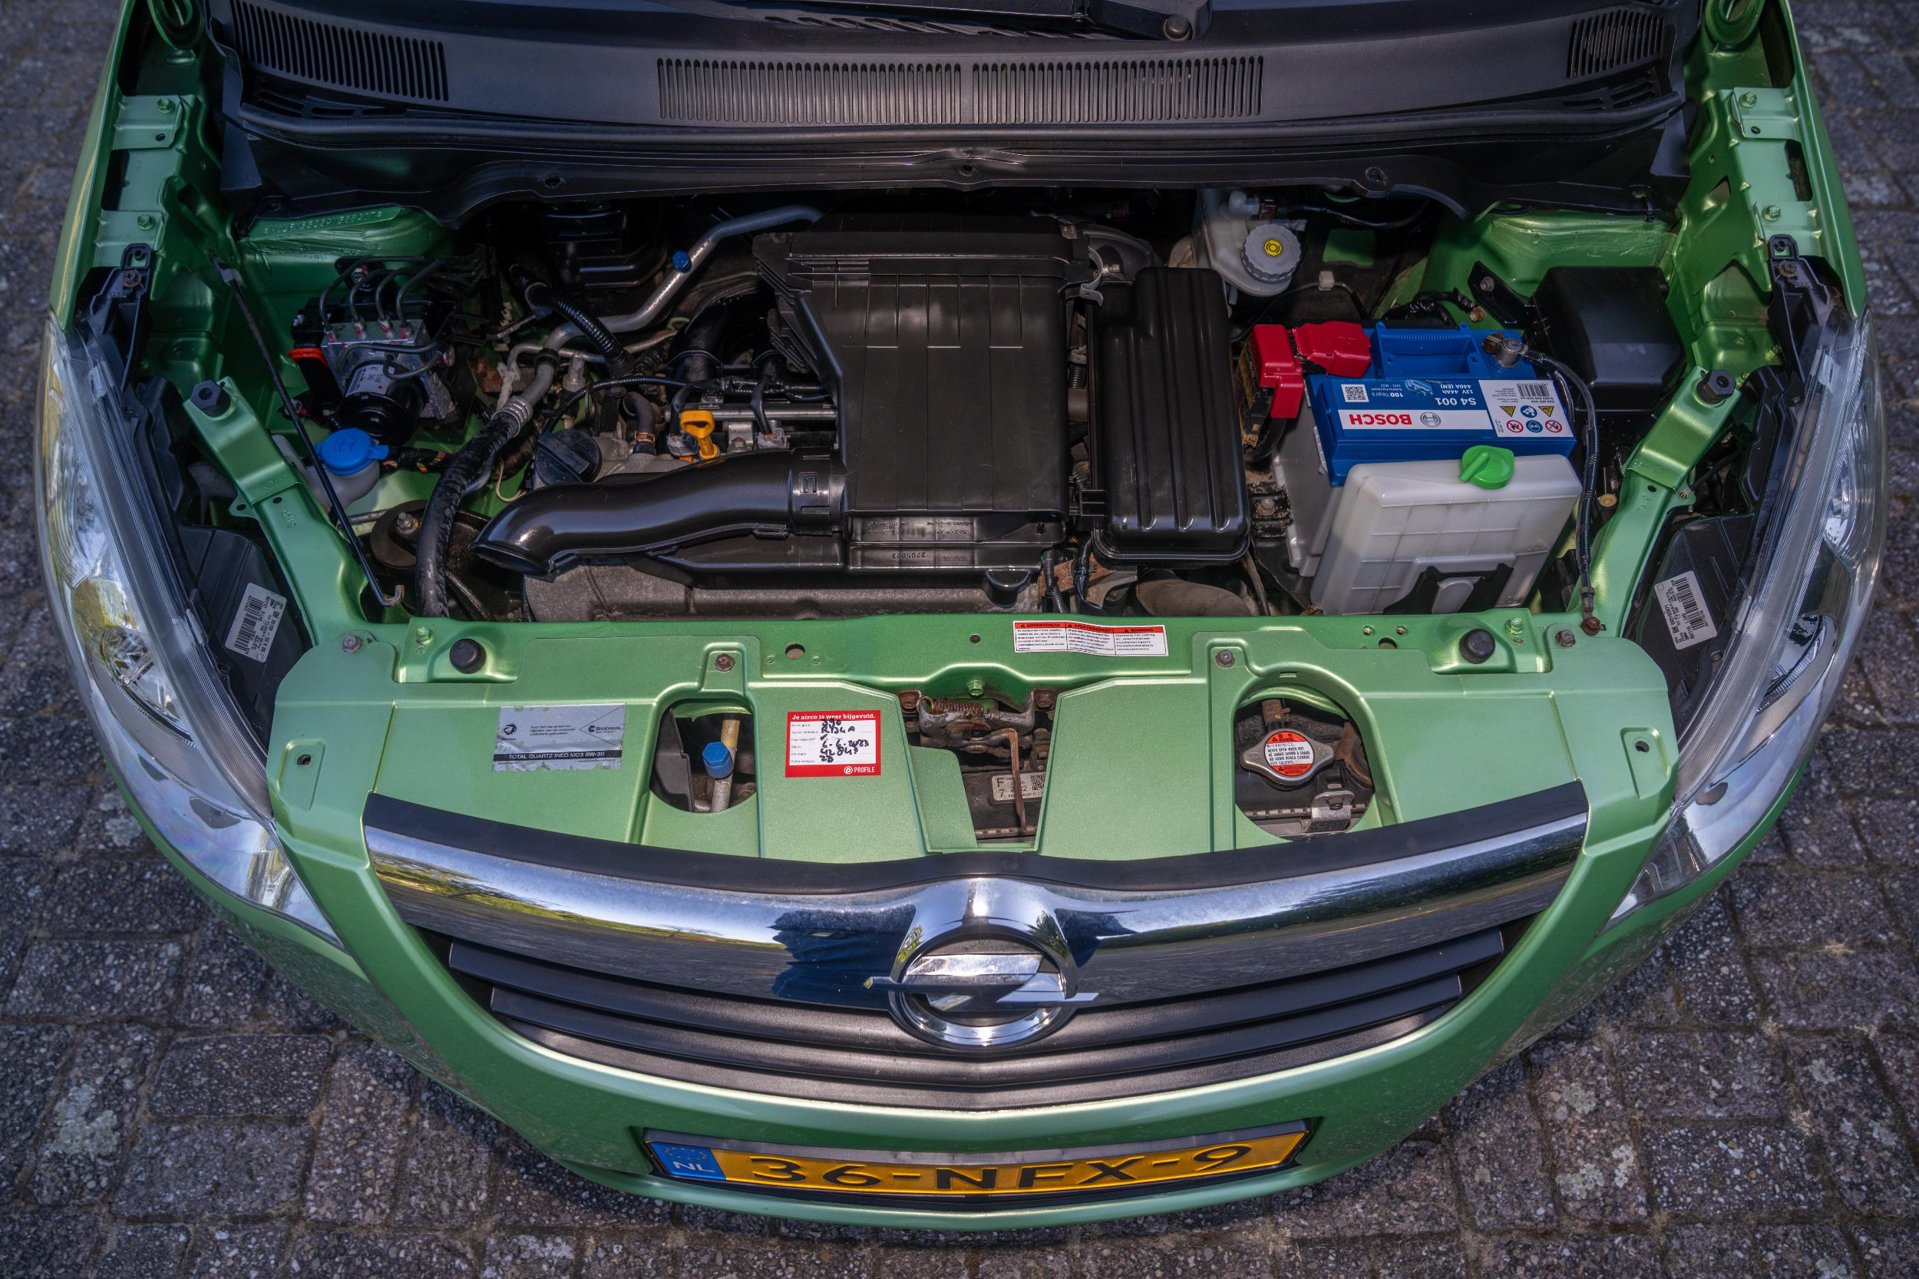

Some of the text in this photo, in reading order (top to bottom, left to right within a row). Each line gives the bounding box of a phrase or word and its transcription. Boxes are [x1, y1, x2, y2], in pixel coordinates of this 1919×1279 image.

[1435, 397, 1477, 406] S4 001
[1349, 414, 1412, 425] BOSCH
[673, 1161, 716, 1173] NL
[750, 1144, 1252, 1190] 36-NFX-9
